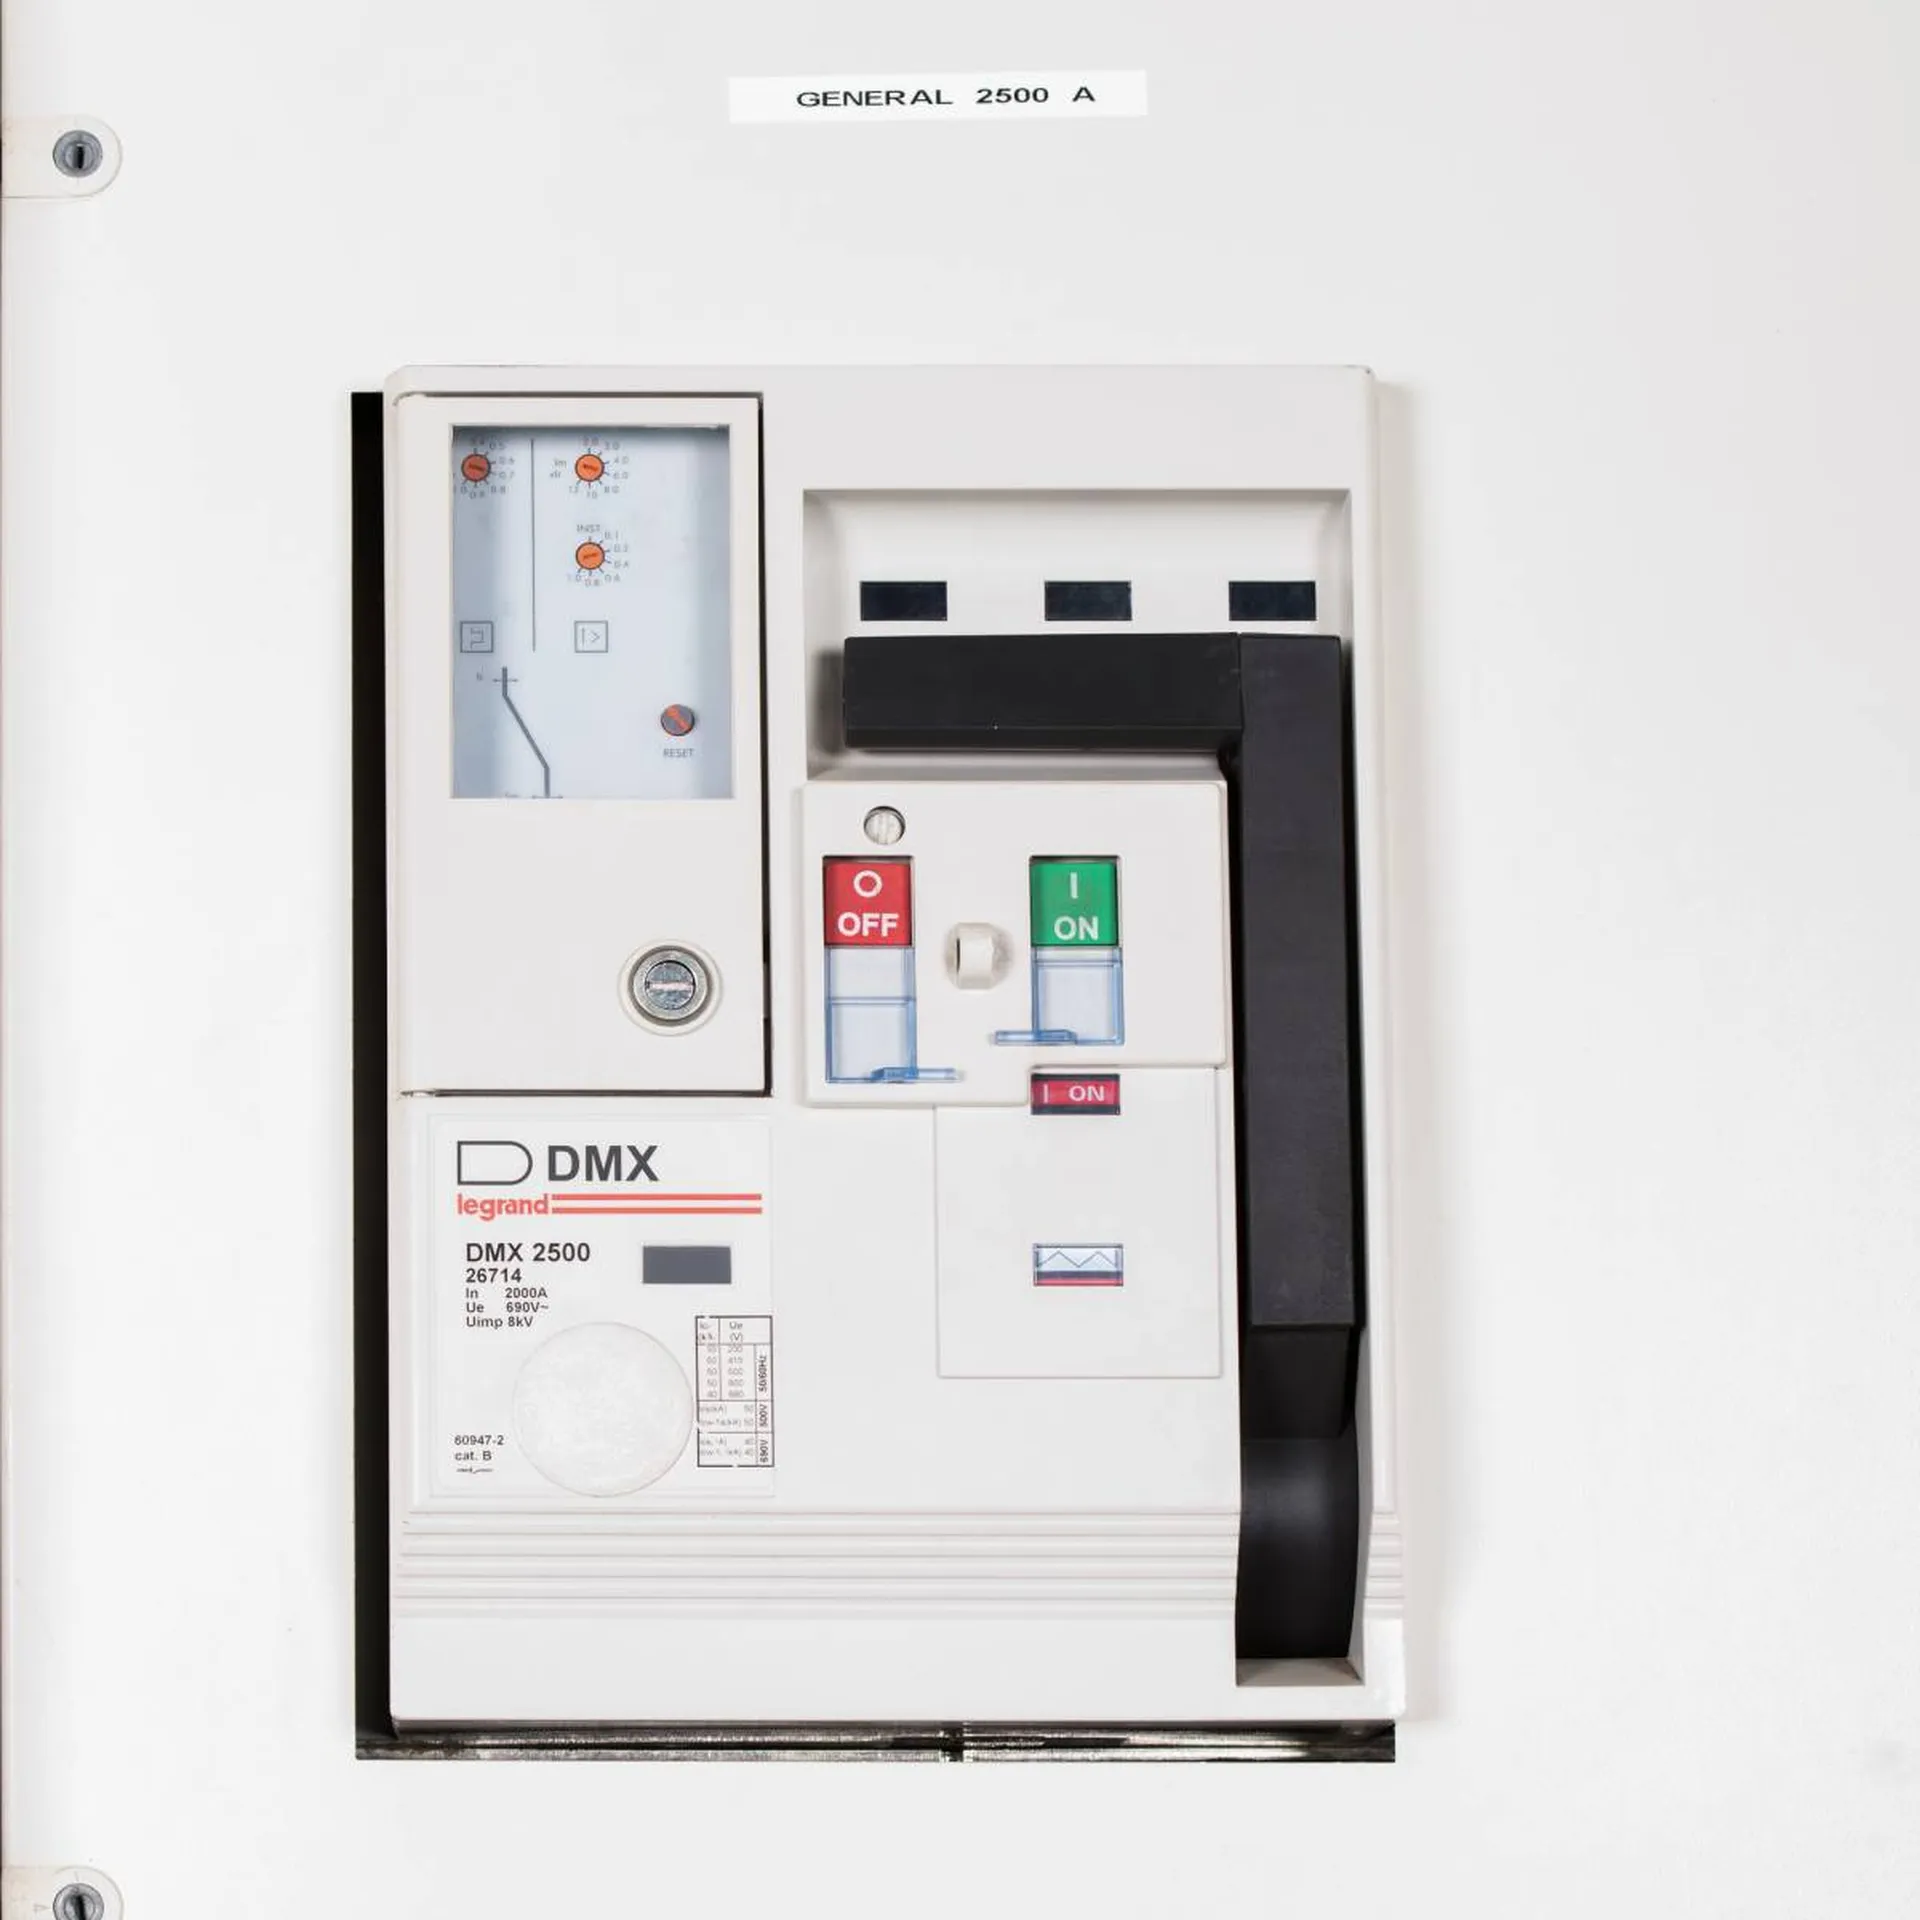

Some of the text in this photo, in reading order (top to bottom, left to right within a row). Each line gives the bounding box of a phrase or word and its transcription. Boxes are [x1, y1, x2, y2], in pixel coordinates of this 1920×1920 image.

[796, 86, 1096, 107] GENERAL 2500 A
[663, 748, 694, 759] RESET
[837, 912, 899, 938] OFF
[1053, 915, 1099, 942] ON
[1068, 1085, 1105, 1102] ON
[547, 1145, 659, 1182] DMX
[457, 1193, 549, 1221] legrand
[466, 1242, 591, 1262] DMX 2500
[465, 1267, 523, 1284] 26714
[465, 1286, 549, 1299] In 2000A
[466, 1301, 485, 1313] Ue
[466, 1315, 534, 1330] Uimp 8kV
[454, 1434, 505, 1445] 60947-2
[454, 1450, 492, 1461] cat. B
